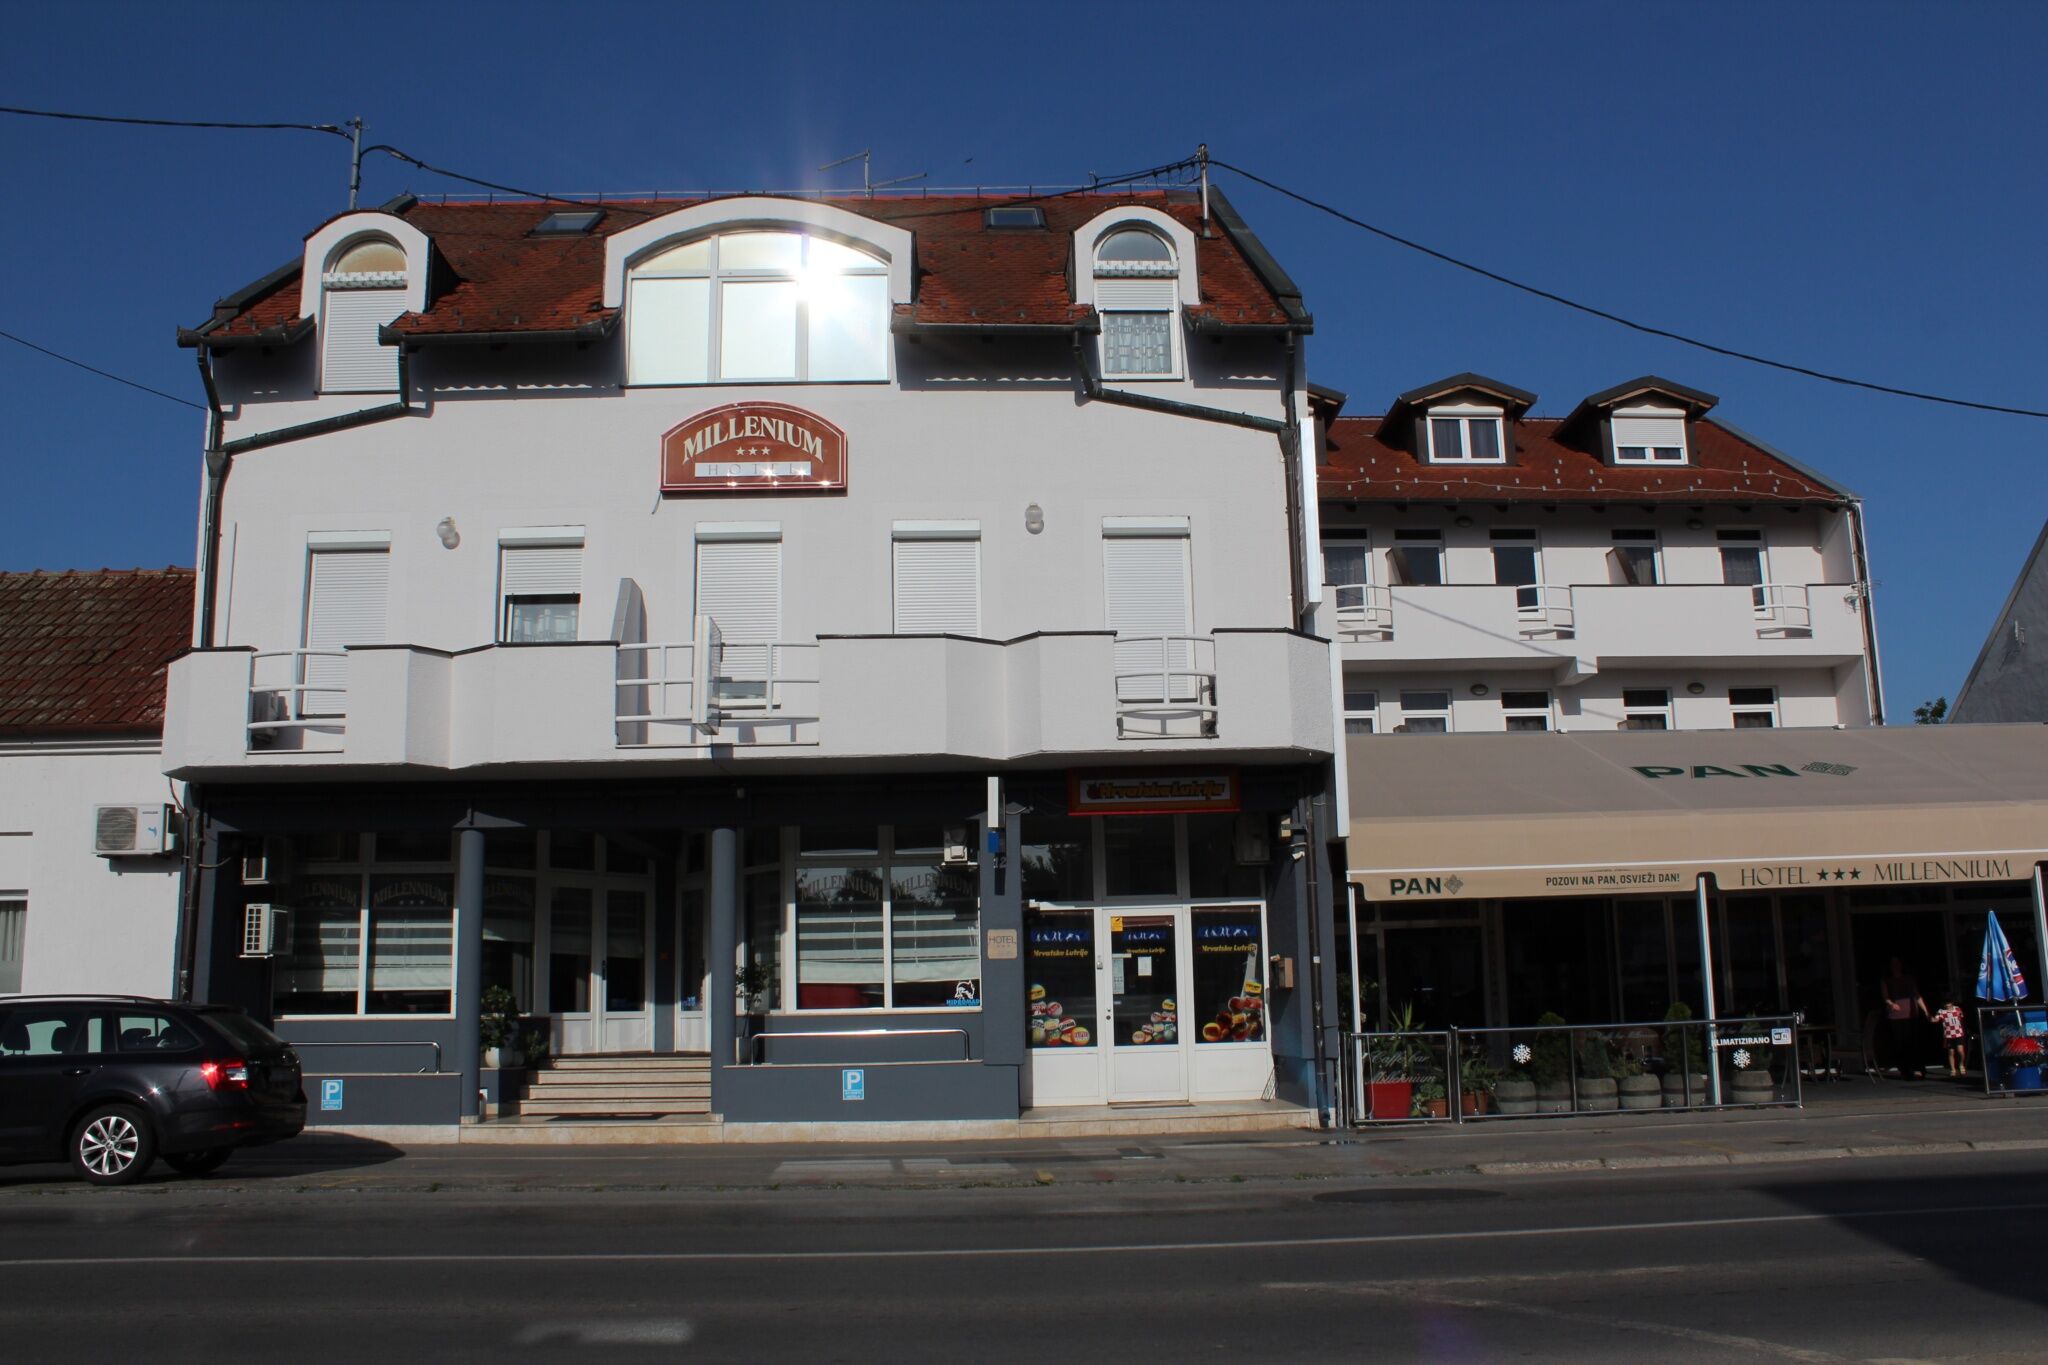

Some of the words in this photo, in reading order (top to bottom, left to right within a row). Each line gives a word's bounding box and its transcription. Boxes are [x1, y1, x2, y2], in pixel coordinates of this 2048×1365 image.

[682, 415, 825, 464] MILLENIUM
[1631, 764, 1801, 779] PAN
[1389, 876, 1442, 896] PAN
[1546, 876, 1579, 887] POZOVI
[1582, 876, 1595, 886] NA
[1620, 871, 1656, 885] OSVJEŽI
[1658, 872, 1680, 883] DAN!
[1740, 866, 1810, 886] HOTEL
[1874, 859, 2011, 882] MILLENNIUM
[372, 879, 449, 907] MILLENNIUM
[802, 874, 880, 901] MILLENNIUM
[989, 935, 1017, 945] HOTEL
[325, 1081, 340, 1100] P
[847, 1071, 861, 1090] P
